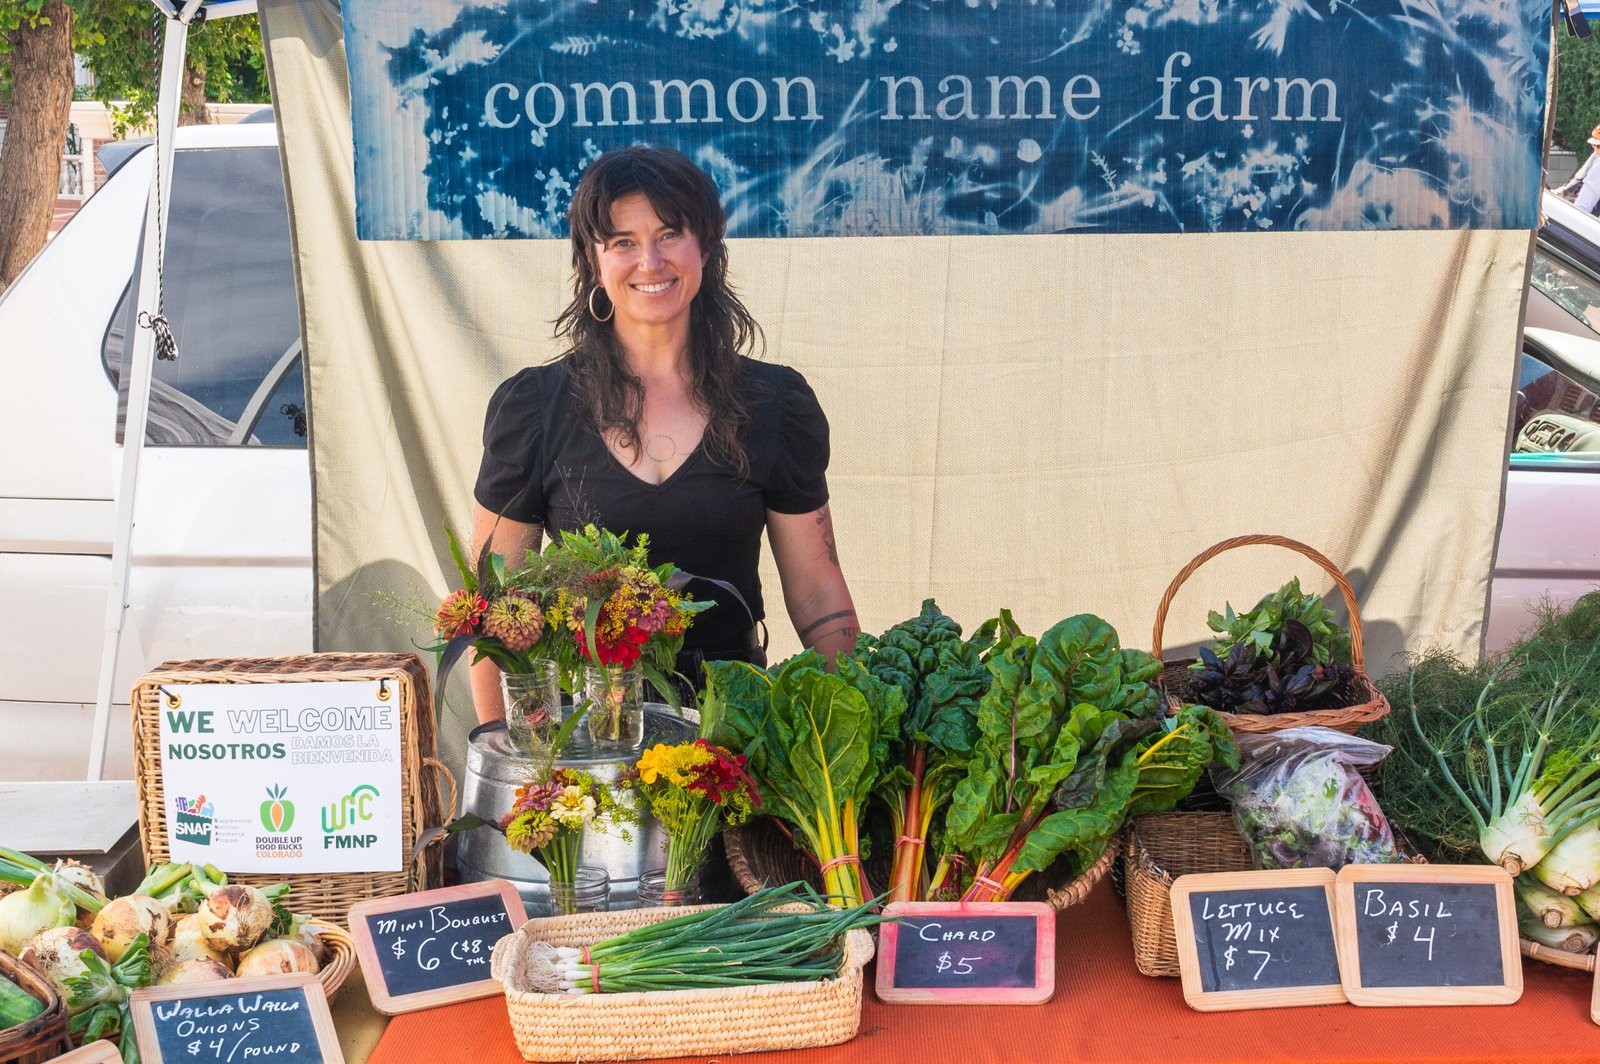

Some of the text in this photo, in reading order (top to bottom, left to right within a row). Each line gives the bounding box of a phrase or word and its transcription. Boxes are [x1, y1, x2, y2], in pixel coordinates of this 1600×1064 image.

[484, 51, 1342, 129] common name farm
[166, 706, 393, 734] WE WELCOME
[168, 742, 286, 760] NOSOTROS
[291, 734, 380, 750] DAMOS LA
[291, 749, 393, 765] BIENVENIDA
[175, 821, 213, 836] SNAP
[324, 834, 378, 849] FMNP
[1202, 898, 1305, 921] LETTUCE
[1364, 889, 1452, 917] BASIL
[377, 906, 507, 934] MINI BOUQUET
[919, 923, 996, 942] CHARD
[1221, 922, 1280, 943] MIX
[935, 950, 982, 975] $5
[156, 994, 300, 1021] WALLA WALLA
[176, 1017, 260, 1037] ONIONS
